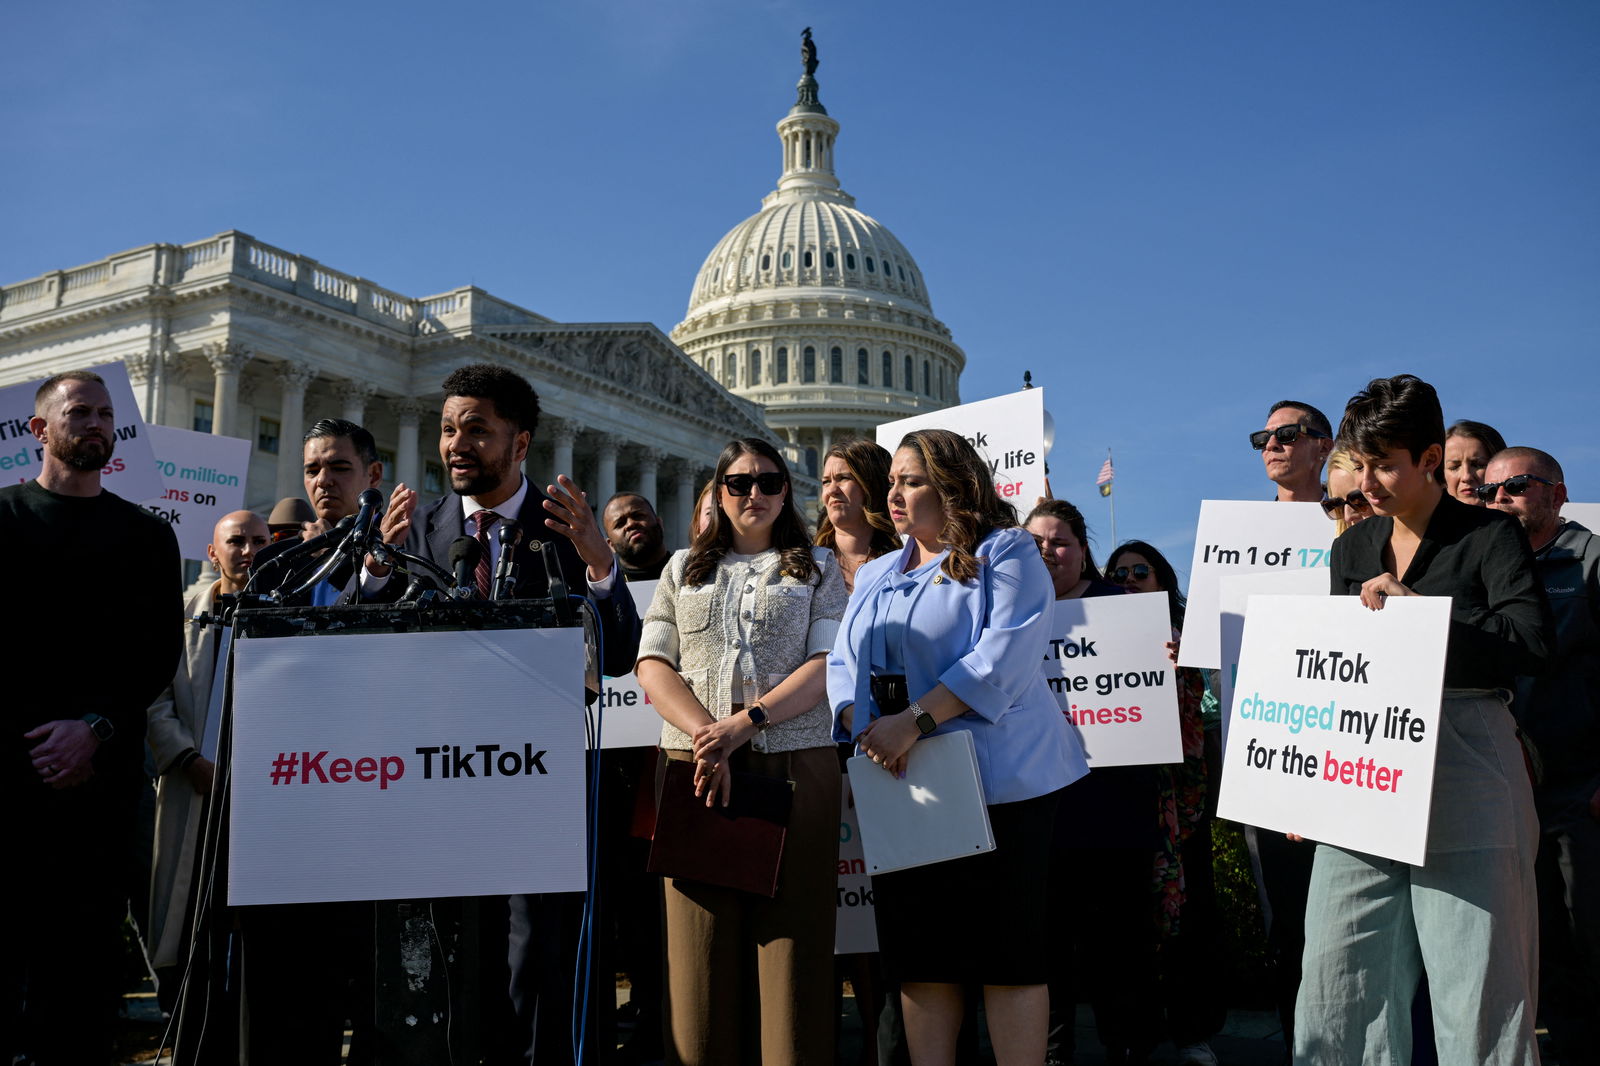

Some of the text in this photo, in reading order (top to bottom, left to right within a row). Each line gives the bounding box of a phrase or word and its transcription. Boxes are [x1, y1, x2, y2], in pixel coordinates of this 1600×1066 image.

[0, 416, 34, 440] Tik
[1005, 449, 1035, 469] life
[180, 466, 239, 487] million
[193, 493, 216, 506] on
[995, 481, 1023, 498] ter
[149, 506, 181, 524] Tok
[1203, 544, 1240, 565] I’m
[1247, 546, 1258, 565] 1
[1264, 547, 1291, 566] of
[1043, 638, 1097, 660] Tok
[1295, 648, 1371, 685] TikTok
[1047, 670, 1165, 696] me grow
[1240, 692, 1426, 745] changed my life
[269, 742, 549, 790] #Keep TikTok
[1246, 738, 1403, 794] for the better
[837, 886, 874, 908] Tok
